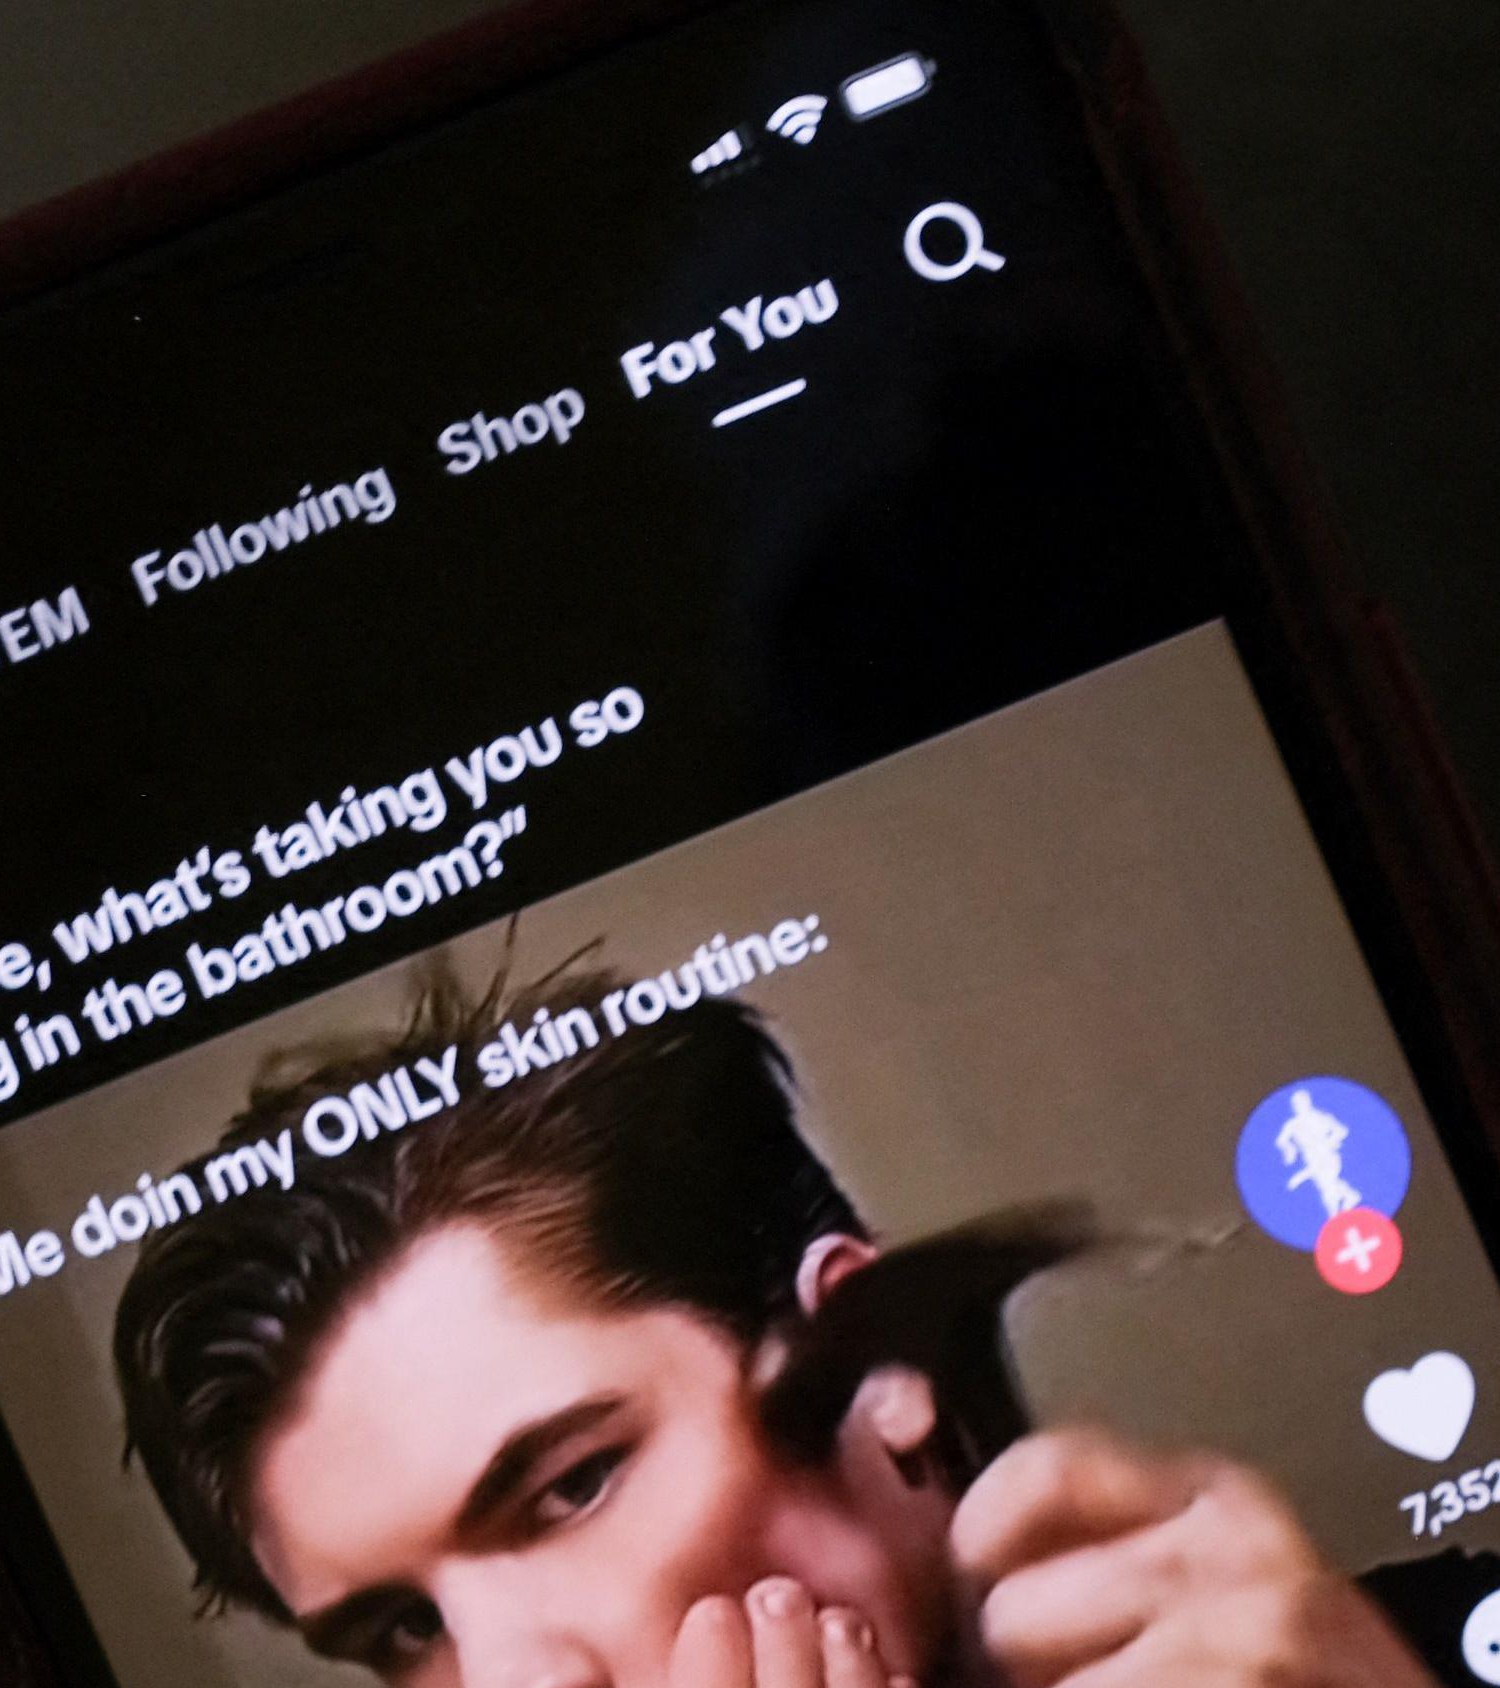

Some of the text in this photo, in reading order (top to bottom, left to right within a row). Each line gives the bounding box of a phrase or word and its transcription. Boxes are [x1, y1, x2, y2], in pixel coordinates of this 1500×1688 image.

[130, 466, 398, 607] Following
[436, 387, 586, 476] Shop
[619, 325, 717, 400] For
[718, 277, 840, 352] You
[250, 766, 448, 879] taking
[445, 715, 564, 811] you
[568, 685, 646, 749] so
[13, 1012, 82, 1072] in
[80, 968, 188, 1042] the
[70, 1171, 203, 1259] doin
[203, 1128, 296, 1204] my
[301, 1045, 461, 1158] ONLY
[476, 1006, 600, 1089] skin
[600, 912, 830, 1038] routine:
